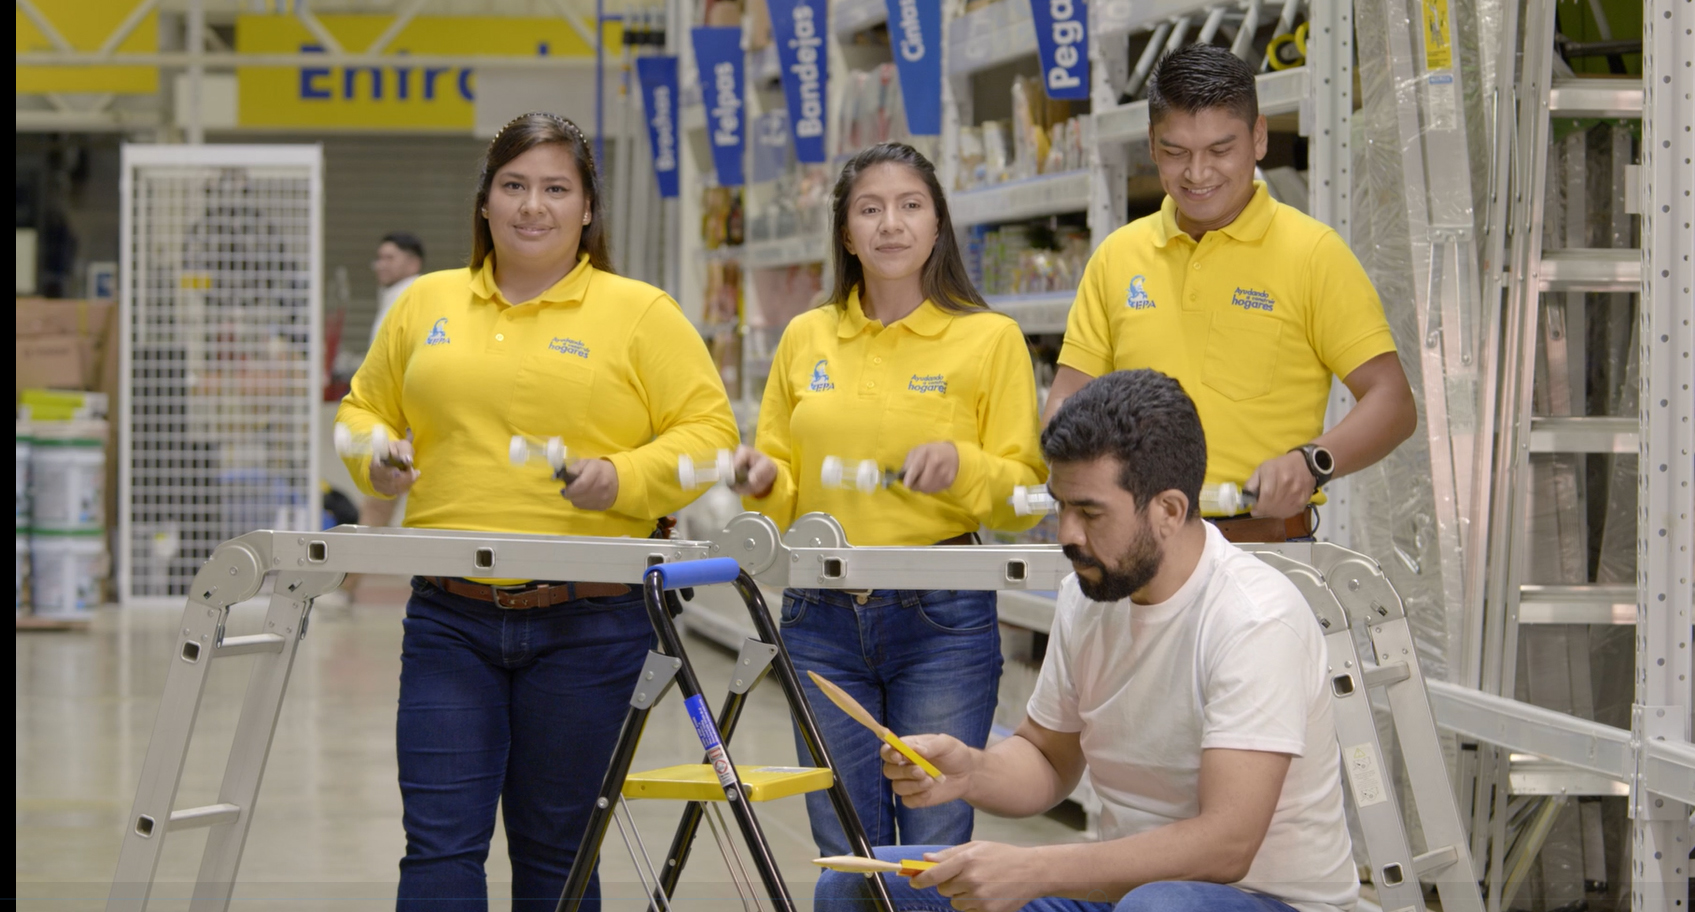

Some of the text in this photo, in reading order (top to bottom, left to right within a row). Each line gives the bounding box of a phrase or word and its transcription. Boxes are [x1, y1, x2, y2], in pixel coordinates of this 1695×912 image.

[788, 5, 823, 138] Bandejas
[711, 62, 742, 146] Felpas
[651, 85, 676, 172] Brochas
[1234, 287, 1269, 298] Ayudando
[1136, 299, 1156, 310] EPA
[1231, 294, 1273, 312] hogares
[548, 341, 588, 359] hogares
[815, 383, 835, 392] EPA
